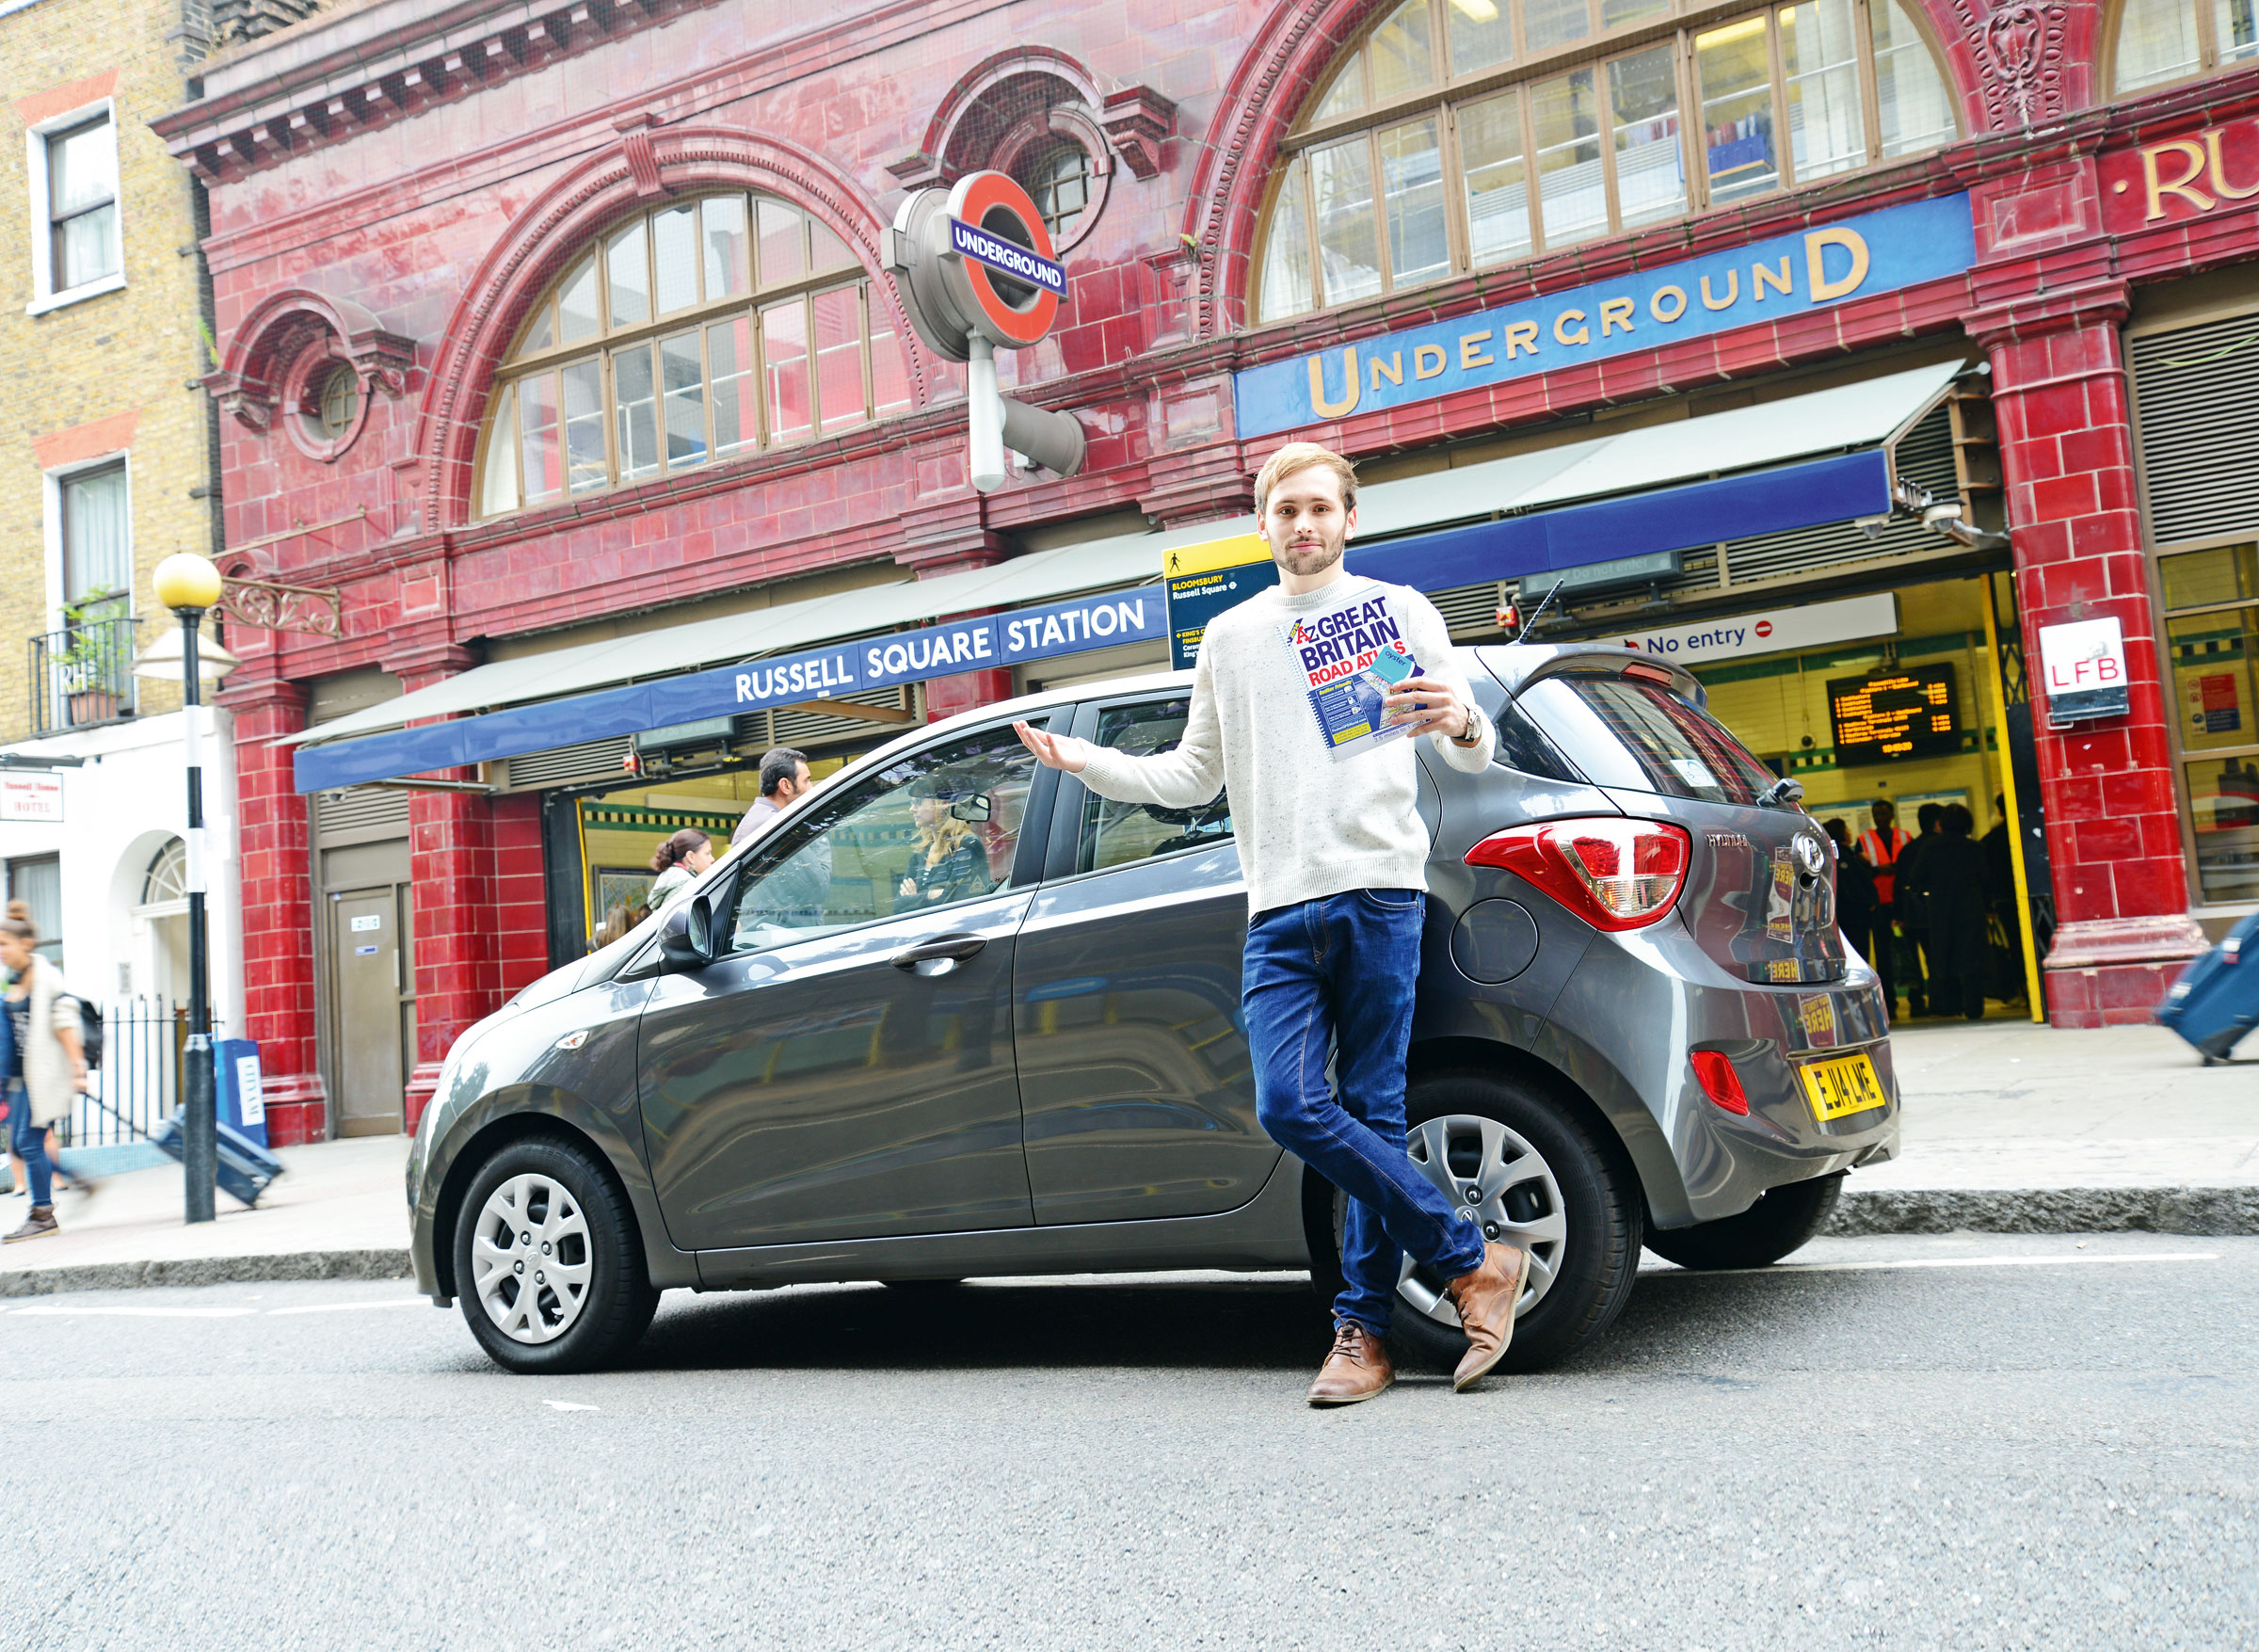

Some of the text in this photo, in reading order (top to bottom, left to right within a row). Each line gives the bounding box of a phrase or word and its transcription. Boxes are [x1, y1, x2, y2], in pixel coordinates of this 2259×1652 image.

[955, 227, 1062, 287] UNDERGROUND
[1308, 226, 1870, 420] UNDERGROUND
[1573, 557, 1648, 579] Do not enter
[1172, 574, 1224, 591] BLOOMSBURY
[1173, 584, 1227, 600] Russell Square
[1318, 596, 1387, 637] GREAT
[735, 598, 1146, 703] RUSSELL SQUARE STATION
[1300, 617, 1401, 672] BRITAIN
[1647, 628, 1745, 653] No entry
[1385, 650, 1407, 666] oyster
[1308, 661, 1354, 686] ROAD
[2052, 657, 2120, 686] LFB
[1384, 730, 1400, 739] miles
[14, 800, 51, 813] HOTEL
[1814, 1062, 1877, 1111] EJ14 LME
